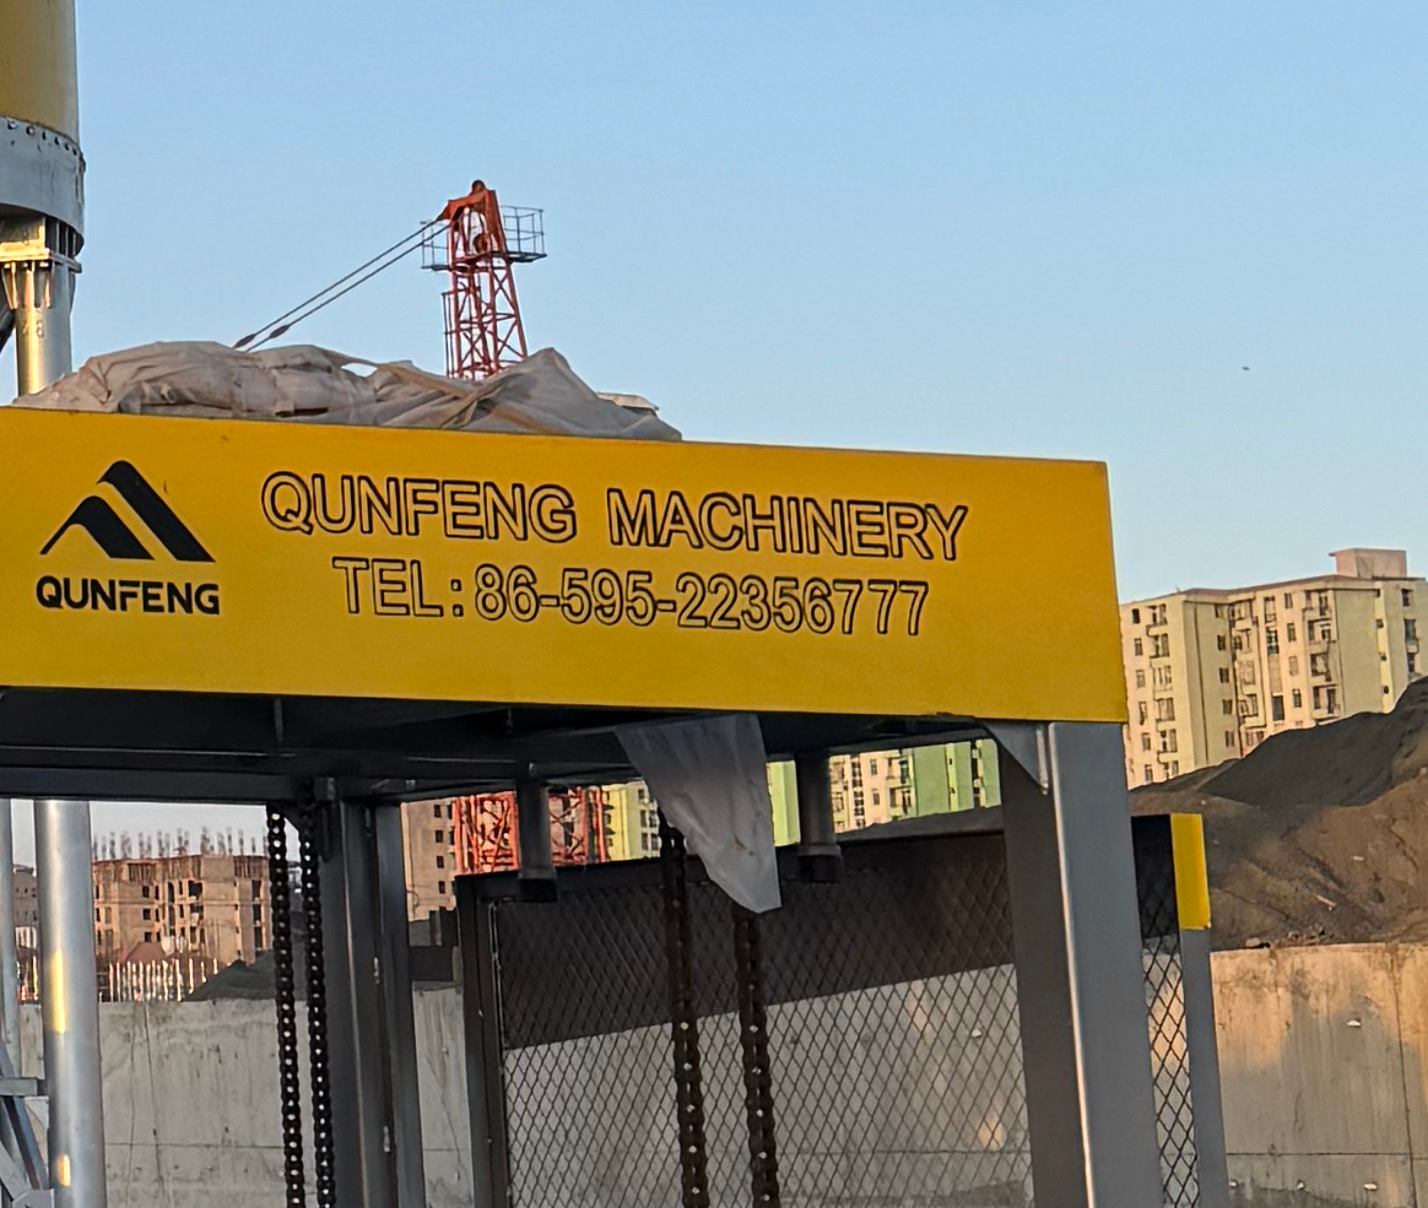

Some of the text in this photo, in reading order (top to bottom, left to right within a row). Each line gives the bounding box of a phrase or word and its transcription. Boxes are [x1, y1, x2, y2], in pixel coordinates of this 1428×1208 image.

[260, 471, 969, 561] QUNFENG MACHINERY
[36, 575, 220, 615] QUNFENG
